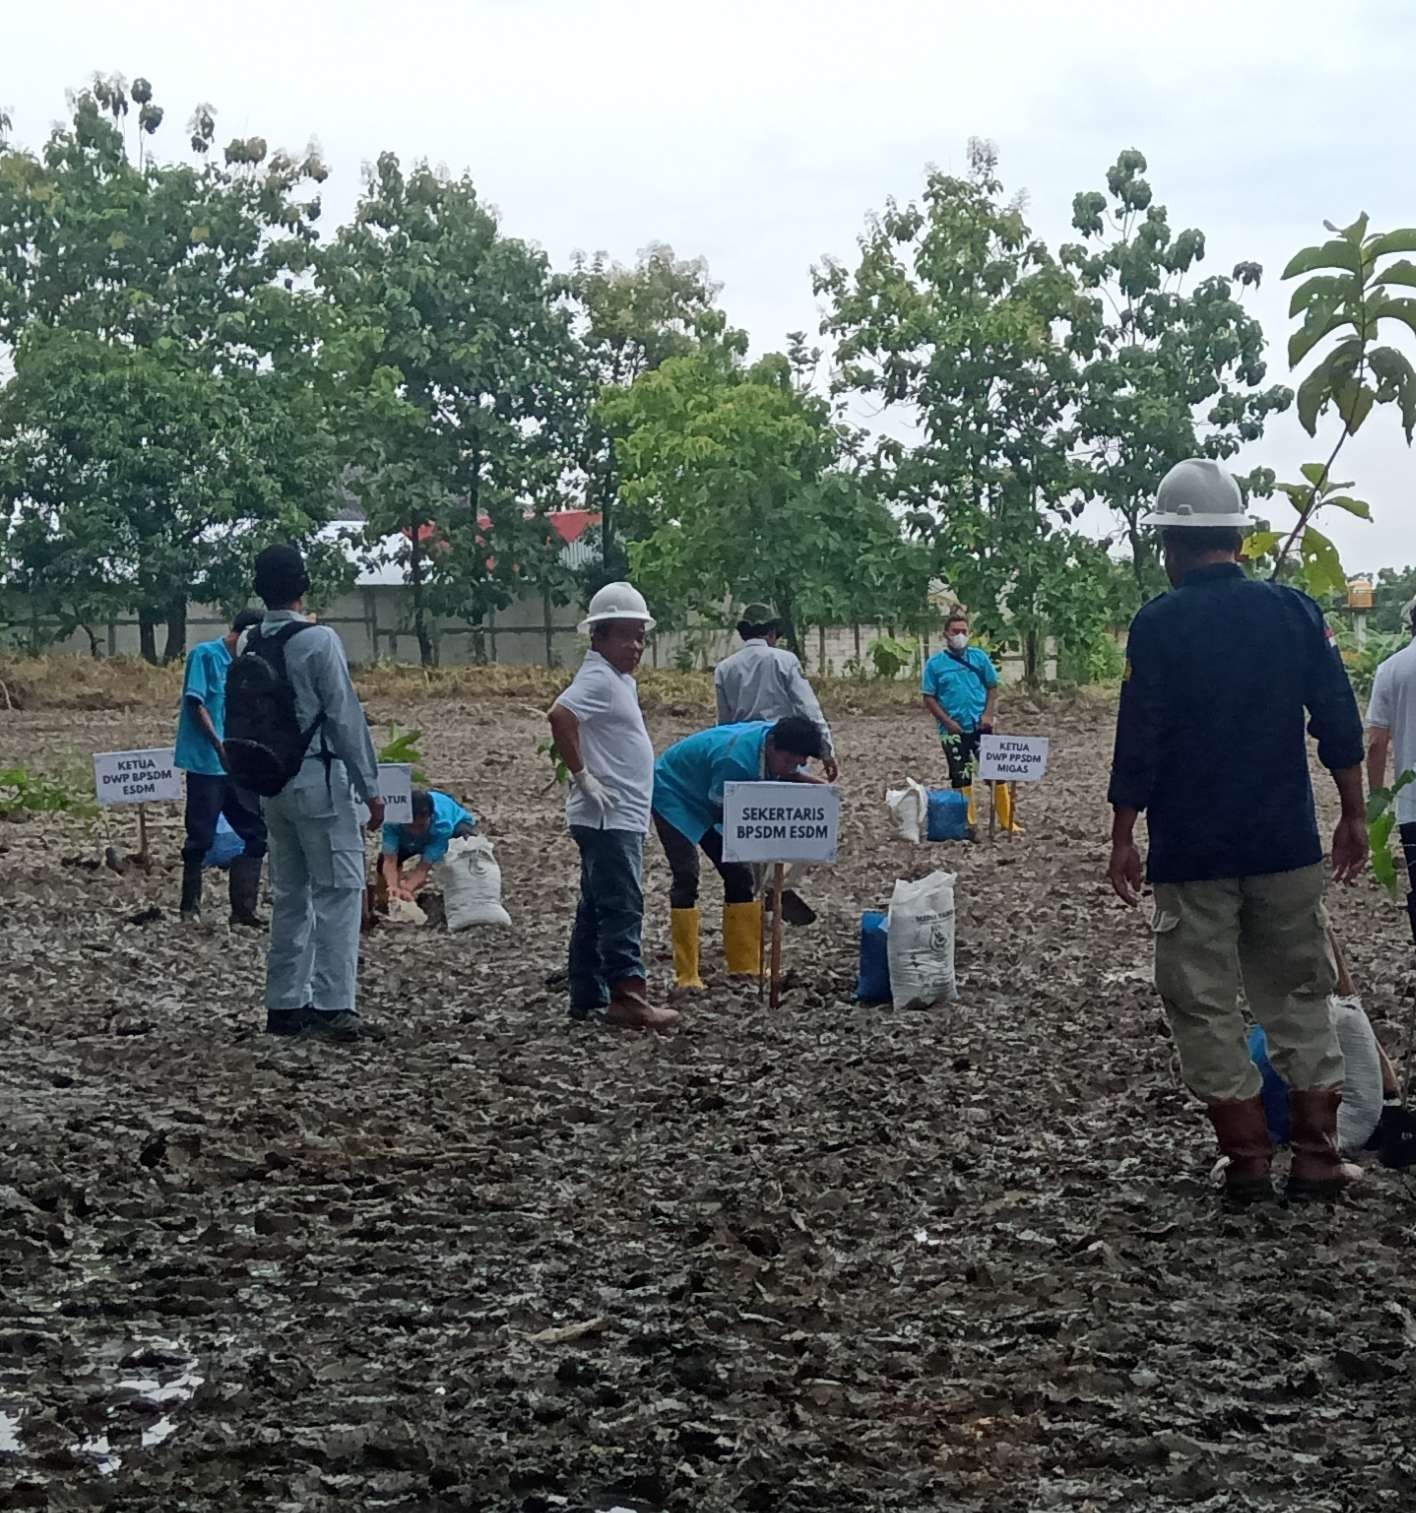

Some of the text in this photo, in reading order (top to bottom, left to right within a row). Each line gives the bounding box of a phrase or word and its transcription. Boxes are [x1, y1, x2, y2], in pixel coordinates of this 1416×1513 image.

[1000, 742, 1029, 752] KETUA
[986, 752, 1007, 761] DWP
[118, 760, 156, 771] KETUA
[997, 764, 1028, 773] MIGAS
[103, 770, 172, 784] DWP BPSDM
[123, 783, 155, 795] ESDM
[742, 807, 825, 821] SEKERTARIS
[737, 825, 828, 839] BPSDM ESDM
